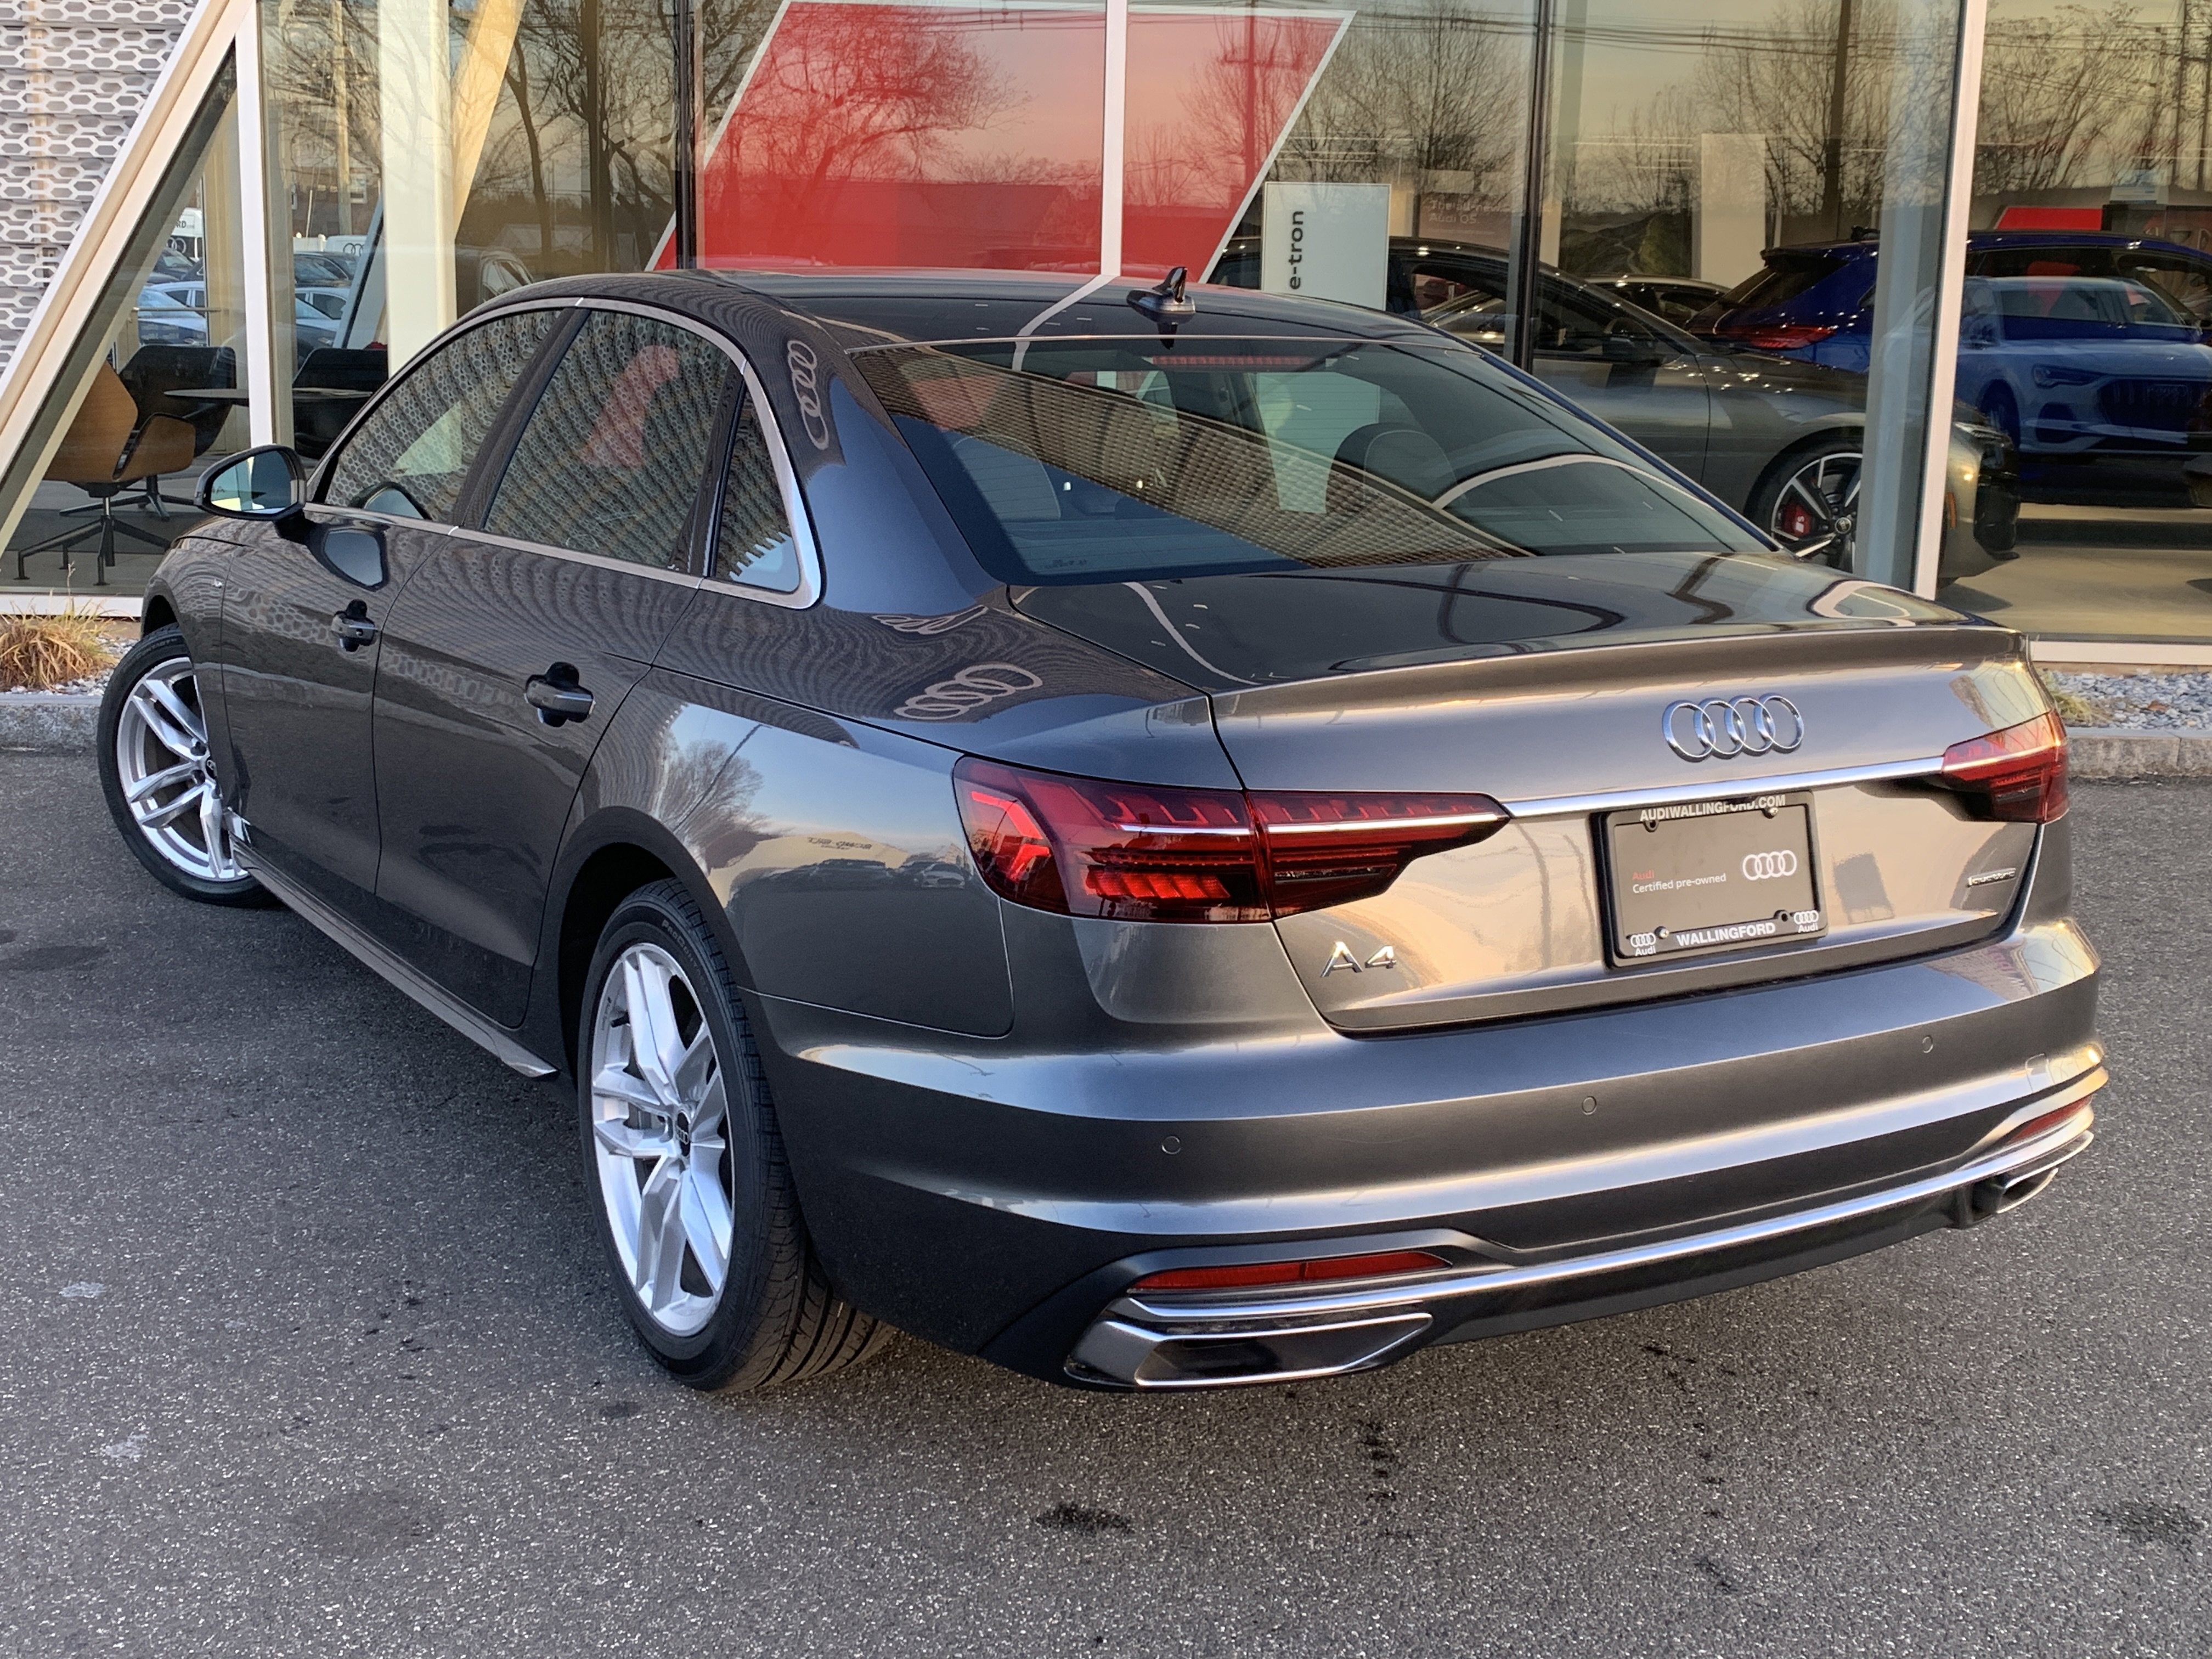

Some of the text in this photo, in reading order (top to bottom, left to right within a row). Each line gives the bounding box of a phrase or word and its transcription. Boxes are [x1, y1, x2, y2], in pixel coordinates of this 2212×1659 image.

[1289, 210, 1304, 290] e-tron
[1632, 870, 1655, 880] Audi
[1632, 873, 1727, 894] Certified pre-owned
[1676, 922, 1776, 947] WALLINGFORD
[1798, 924, 1819, 933] Audi
[1319, 941, 1397, 978] A4
[1635, 947, 1657, 957] Audi
